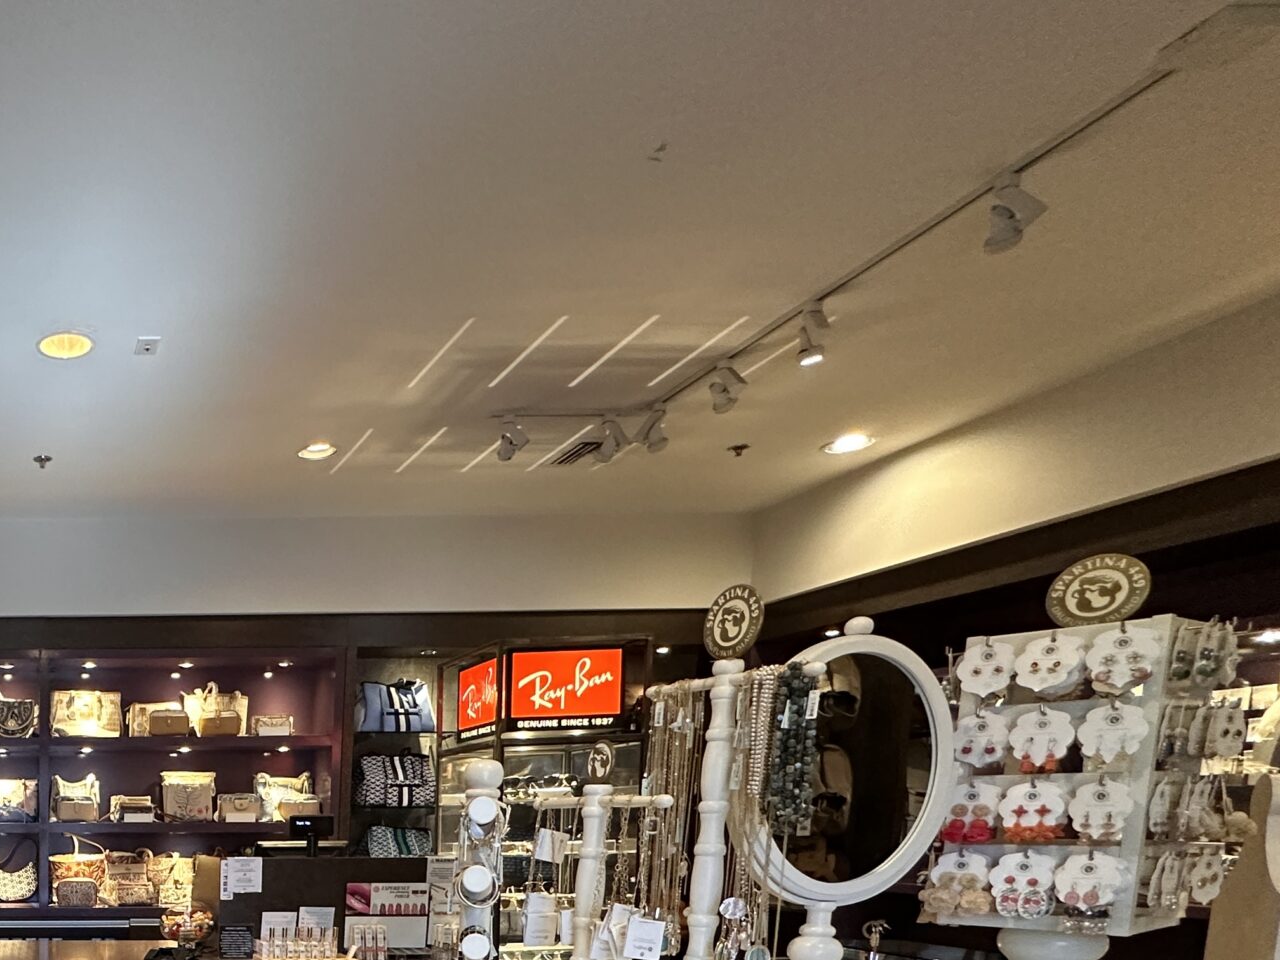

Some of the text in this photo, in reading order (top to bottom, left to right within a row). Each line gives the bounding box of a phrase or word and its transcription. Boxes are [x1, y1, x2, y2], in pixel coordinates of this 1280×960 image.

[1051, 557, 1146, 598] SPARTINA 449
[706, 586, 760, 628] SPARTINA 449
[518, 657, 614, 710] Ray-Ban
[517, 719, 558, 729] GENUINE
[561, 718, 590, 728] SINCE
